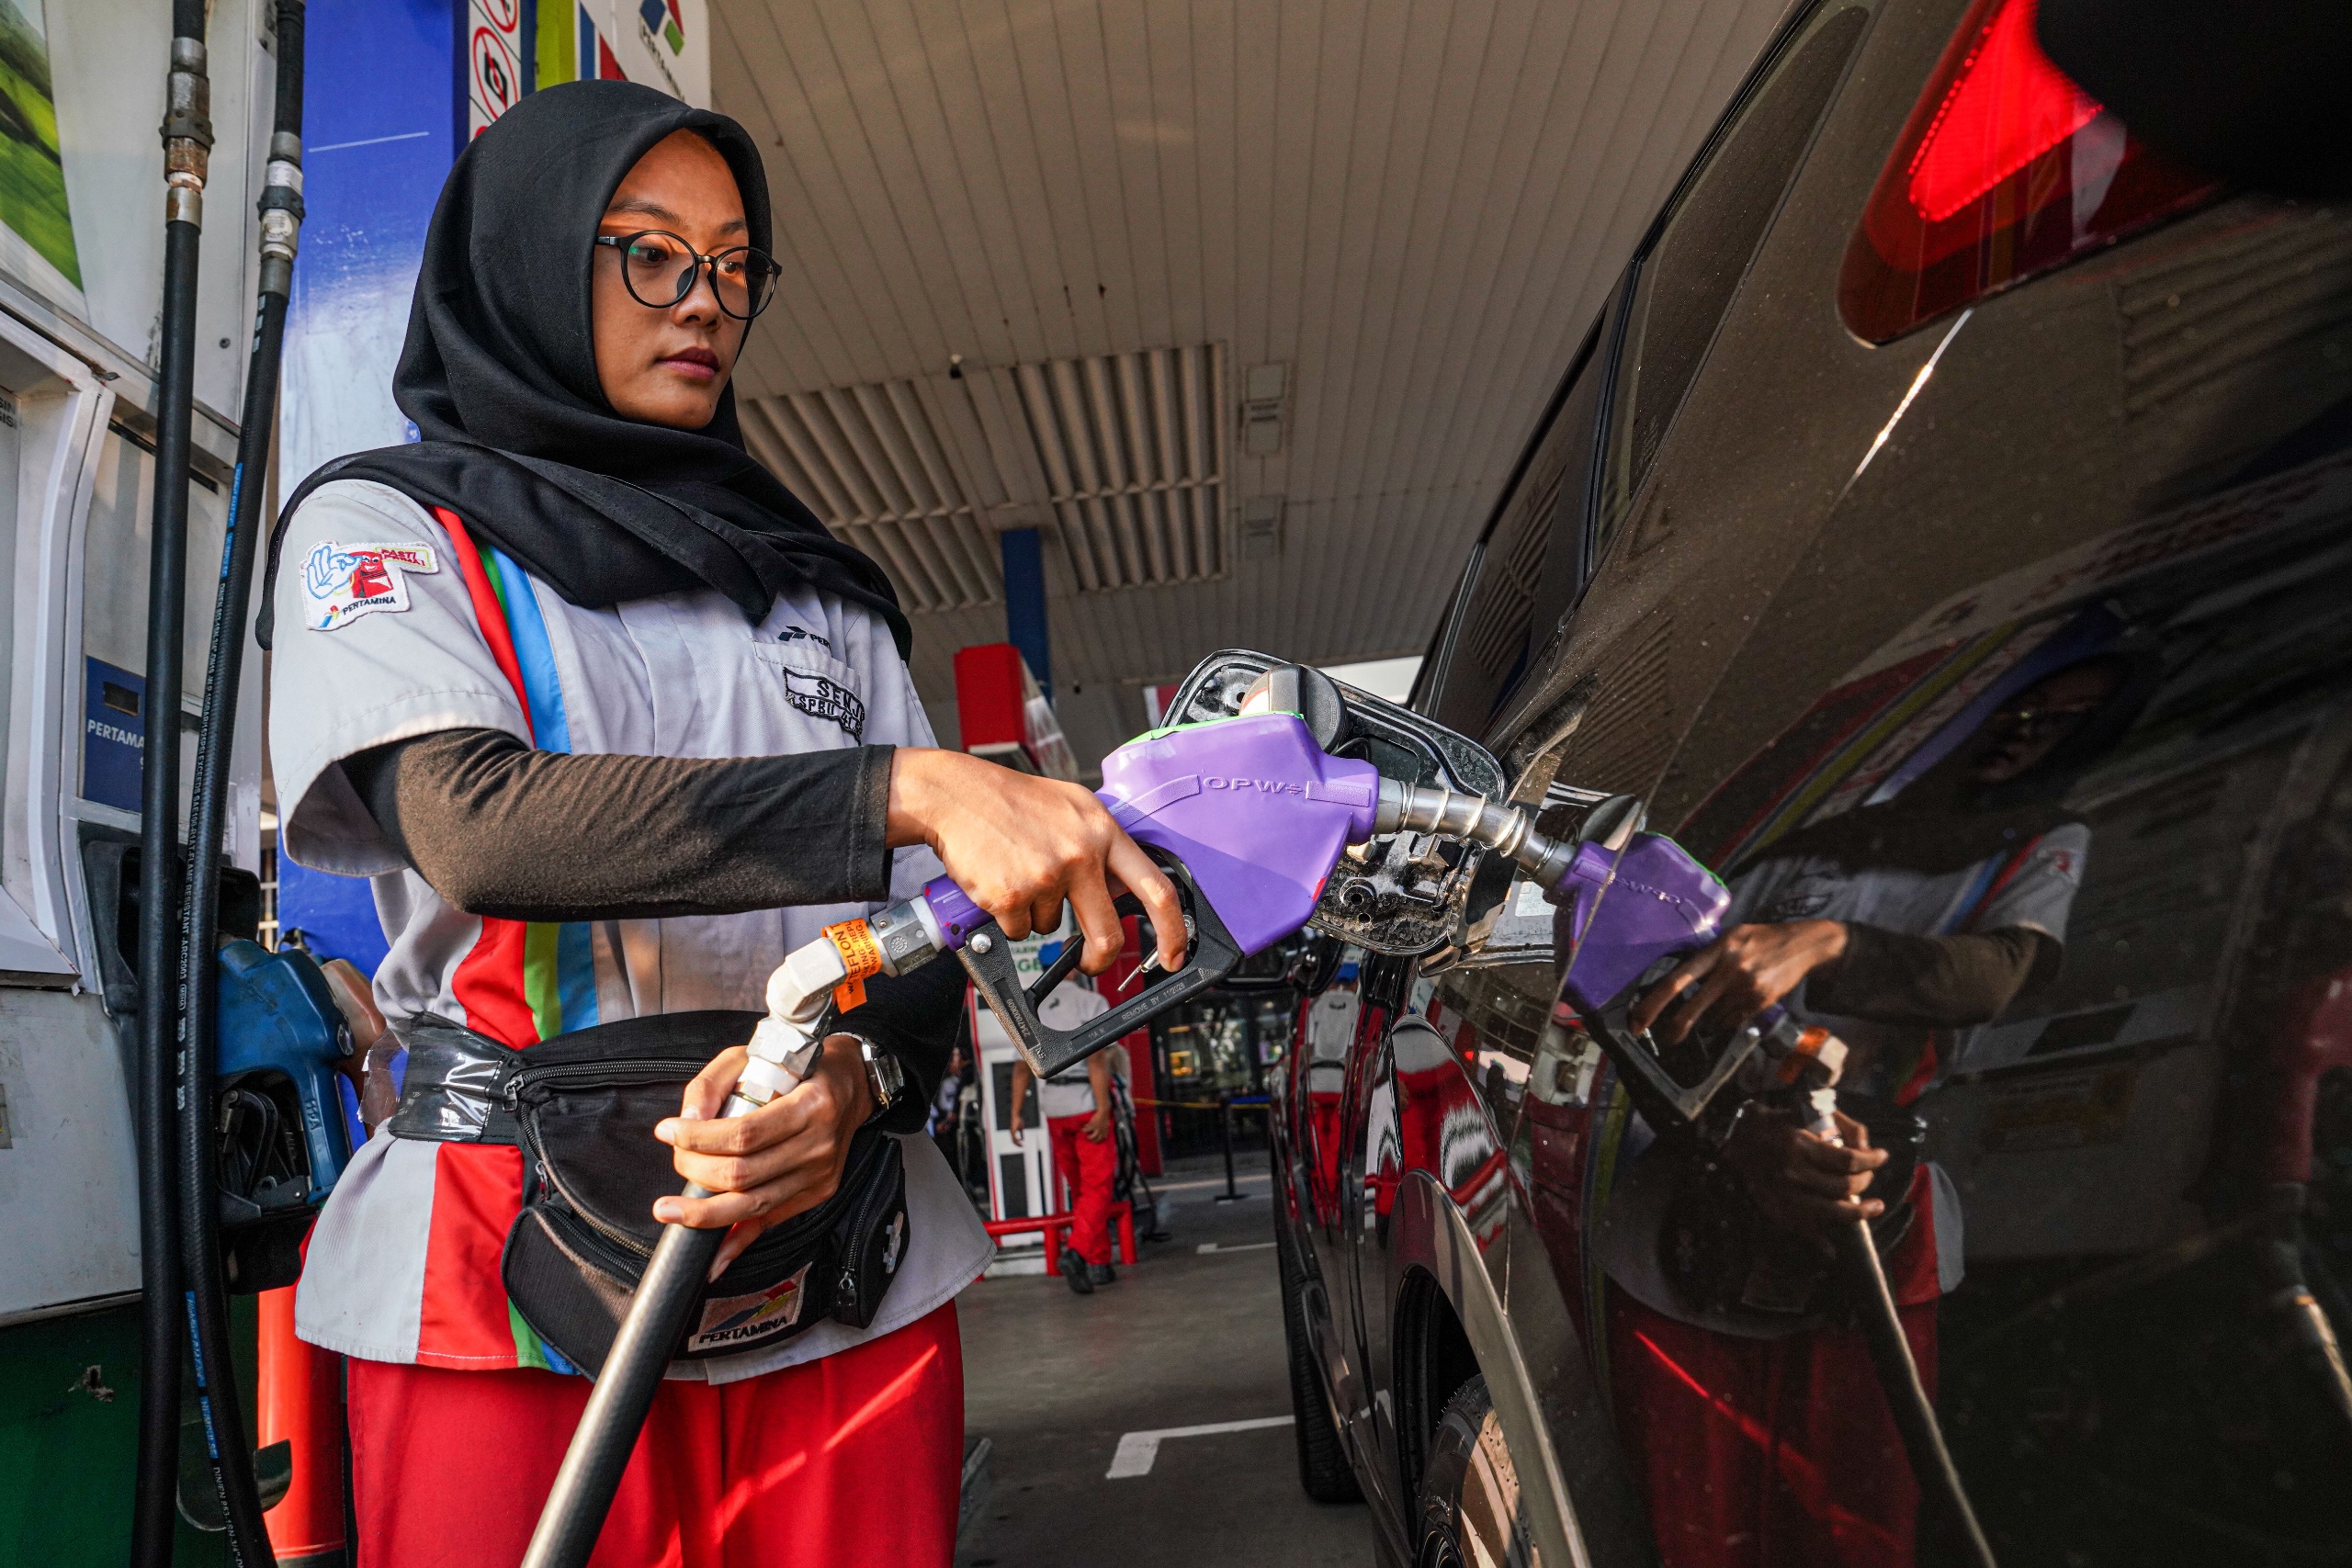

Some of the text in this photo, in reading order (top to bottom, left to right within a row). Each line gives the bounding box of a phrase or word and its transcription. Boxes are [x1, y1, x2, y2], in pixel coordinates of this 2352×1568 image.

[343, 596, 396, 615] PERTAMINA
[1203, 776, 1286, 794] OPW
[835, 931, 861, 980] TEFLON
[855, 921, 878, 965] WARNING.
[1121, 1002, 1148, 1021] REMOVE
[1150, 995, 1160, 1006] BY
[1162, 982, 1185, 998] 11/2028
[698, 1315, 788, 1344] PERTAMINA
